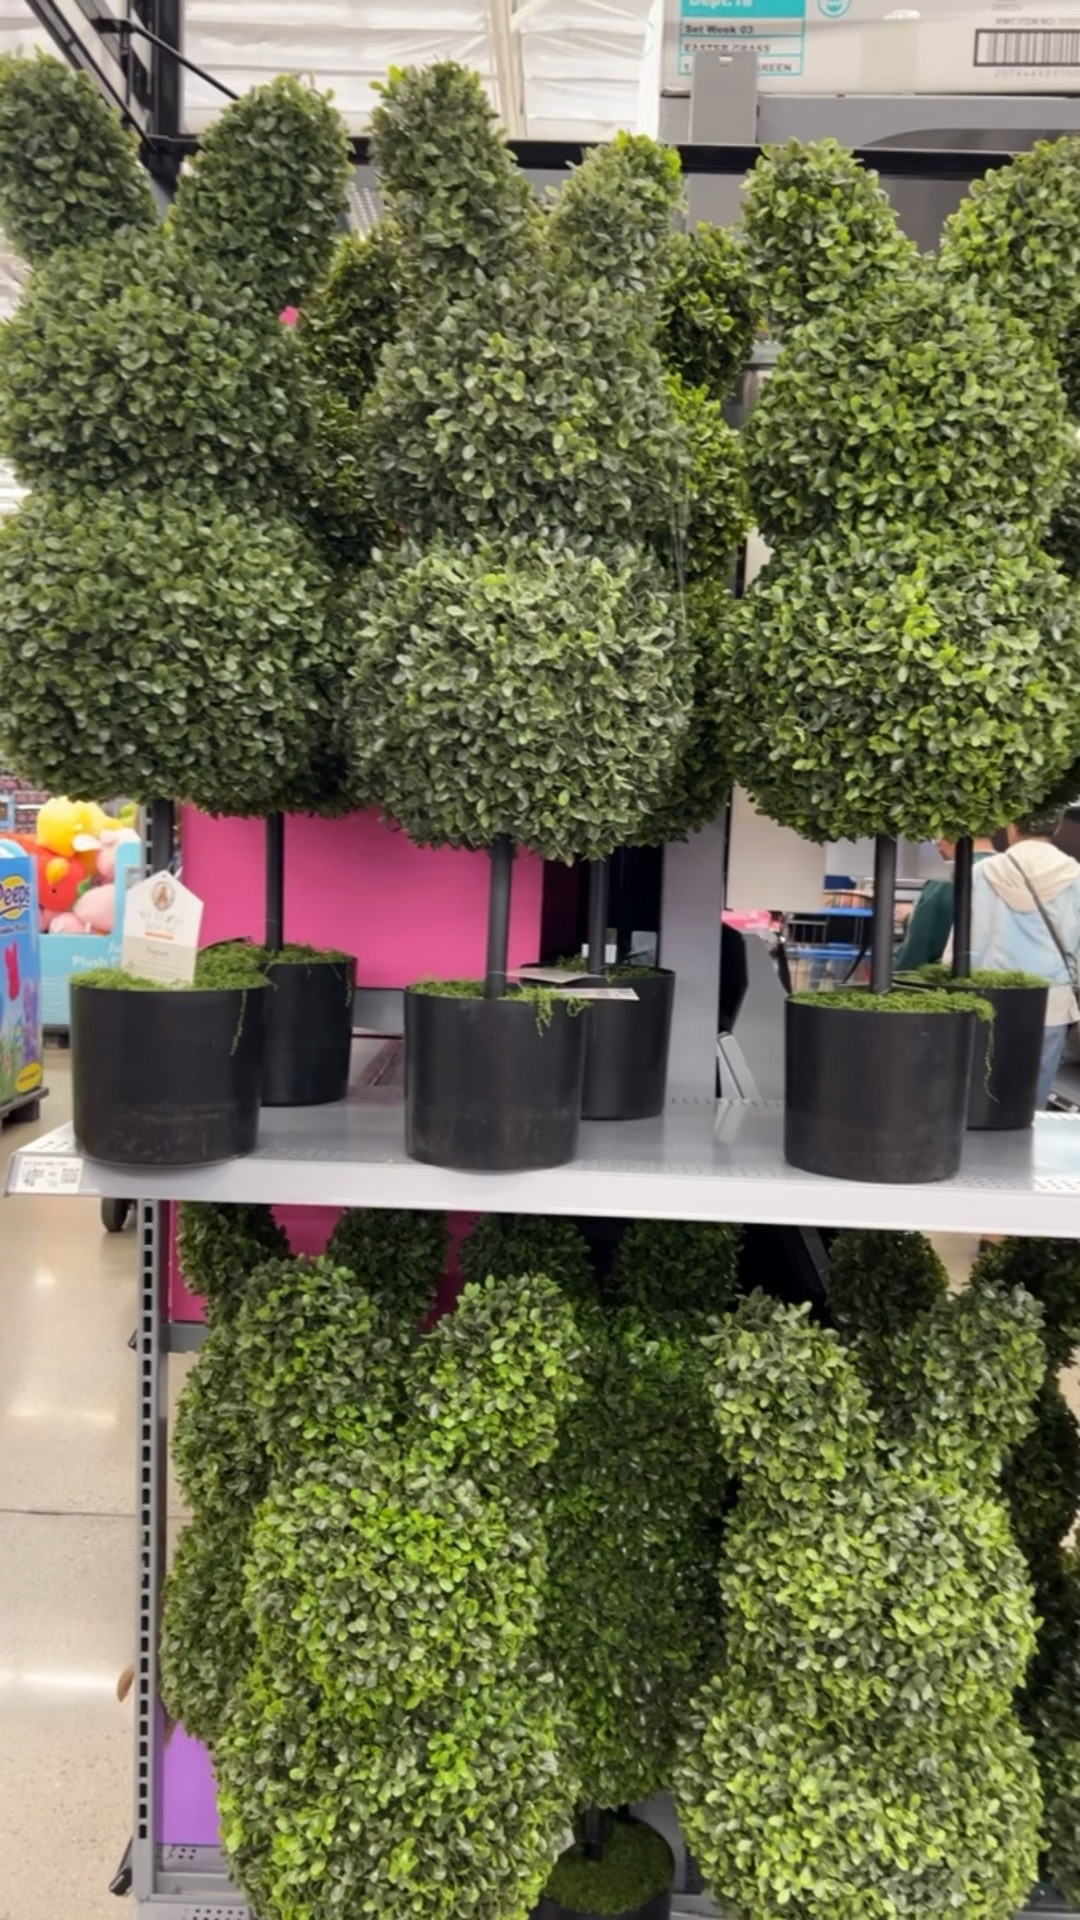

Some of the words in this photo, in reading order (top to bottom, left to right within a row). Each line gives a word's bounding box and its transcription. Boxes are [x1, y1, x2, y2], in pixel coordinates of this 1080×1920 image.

[685, 25, 704, 34] Set
[707, 25, 736, 34] Week
[757, 63, 793, 72] REEN
